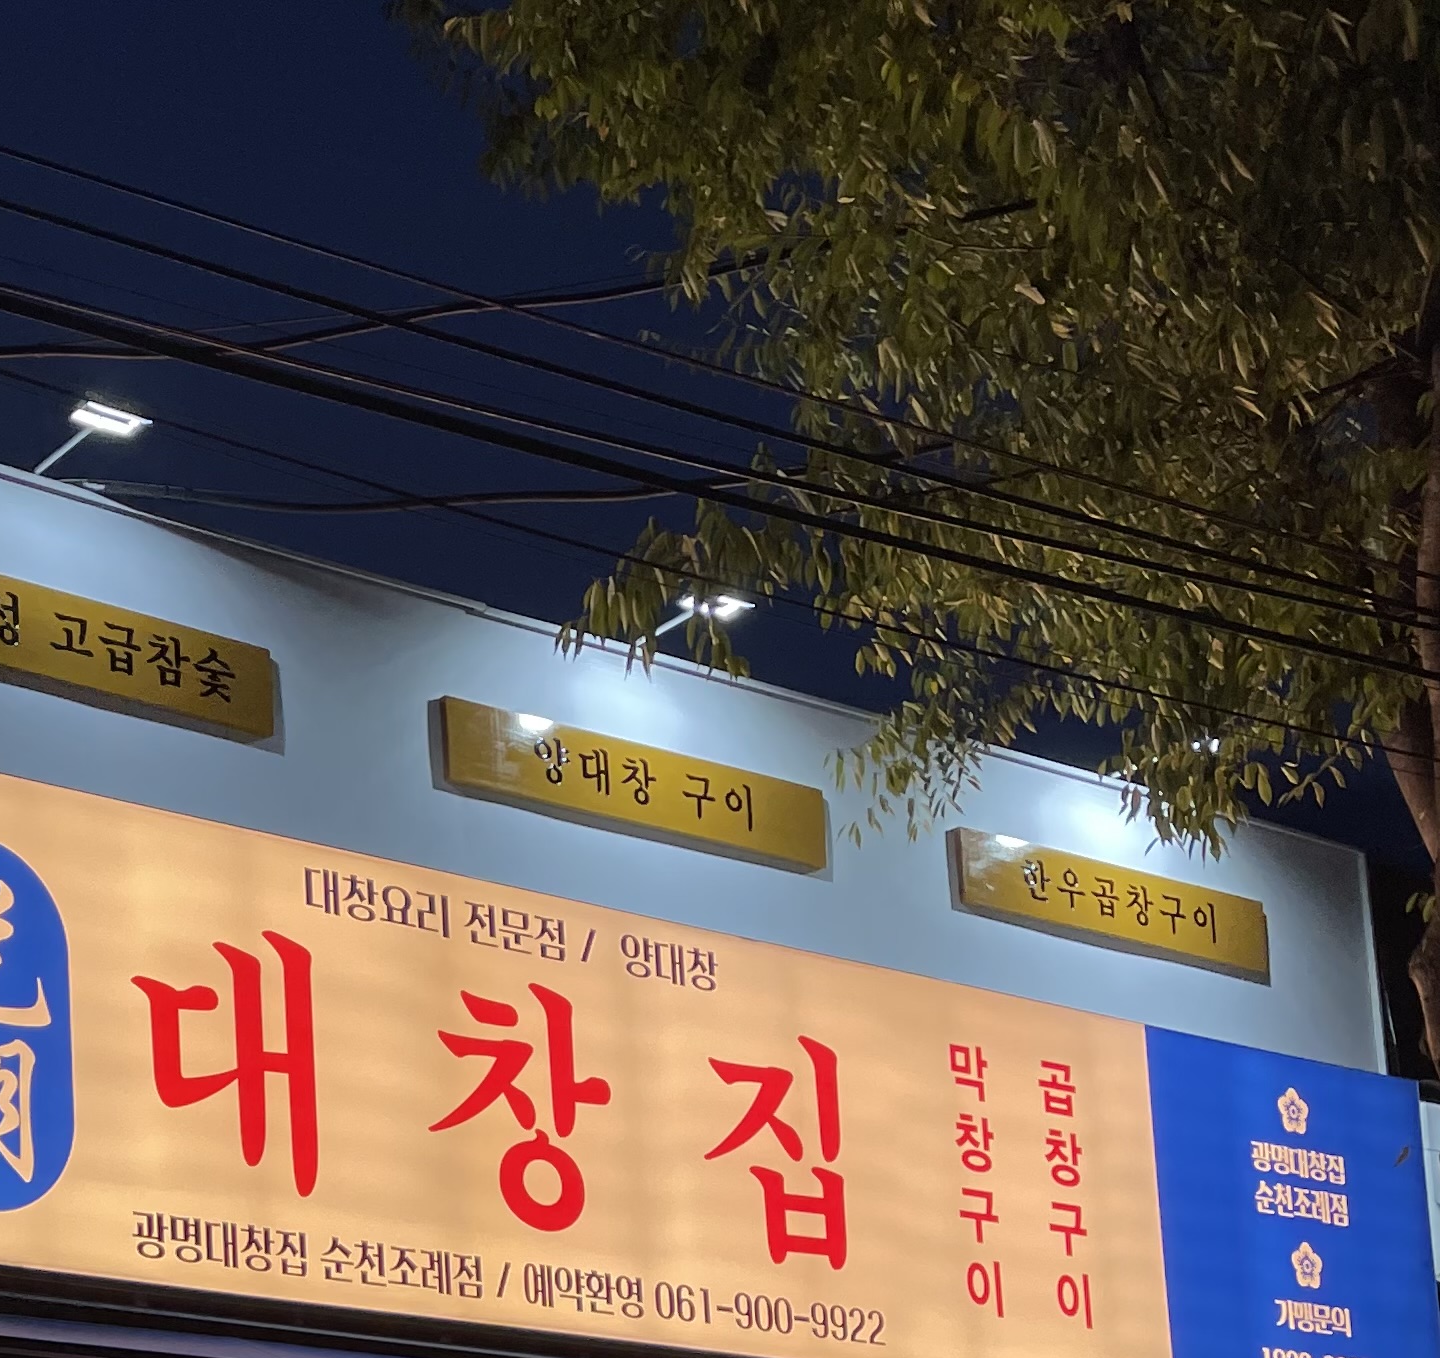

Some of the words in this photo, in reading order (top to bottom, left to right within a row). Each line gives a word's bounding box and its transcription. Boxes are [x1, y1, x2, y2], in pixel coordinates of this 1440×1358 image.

[50, 612, 237, 703] 고급참숯
[533, 736, 657, 806] 양대창
[682, 773, 754, 832] 구이
[305, 866, 452, 939] 대창요리
[464, 900, 567, 961] 전문점
[620, 932, 718, 992] 양대창
[1021, 858, 1218, 945] 한우곱창구이
[131, 931, 846, 1269] 대창집
[950, 1044, 1003, 1317] 막창구이
[1039, 1061, 1092, 1328] 곱창구이
[1250, 1140, 1346, 1186] 광명대창집
[1255, 1180, 1350, 1227] 순천조례점
[132, 1211, 308, 1277] 광명대창집
[320, 1236, 484, 1299] 순천조례점
[524, 1261, 645, 1318] 예약환영
[654, 1281, 887, 1346] 061-900-9922
[1274, 1298, 1352, 1338] 가맹문의
